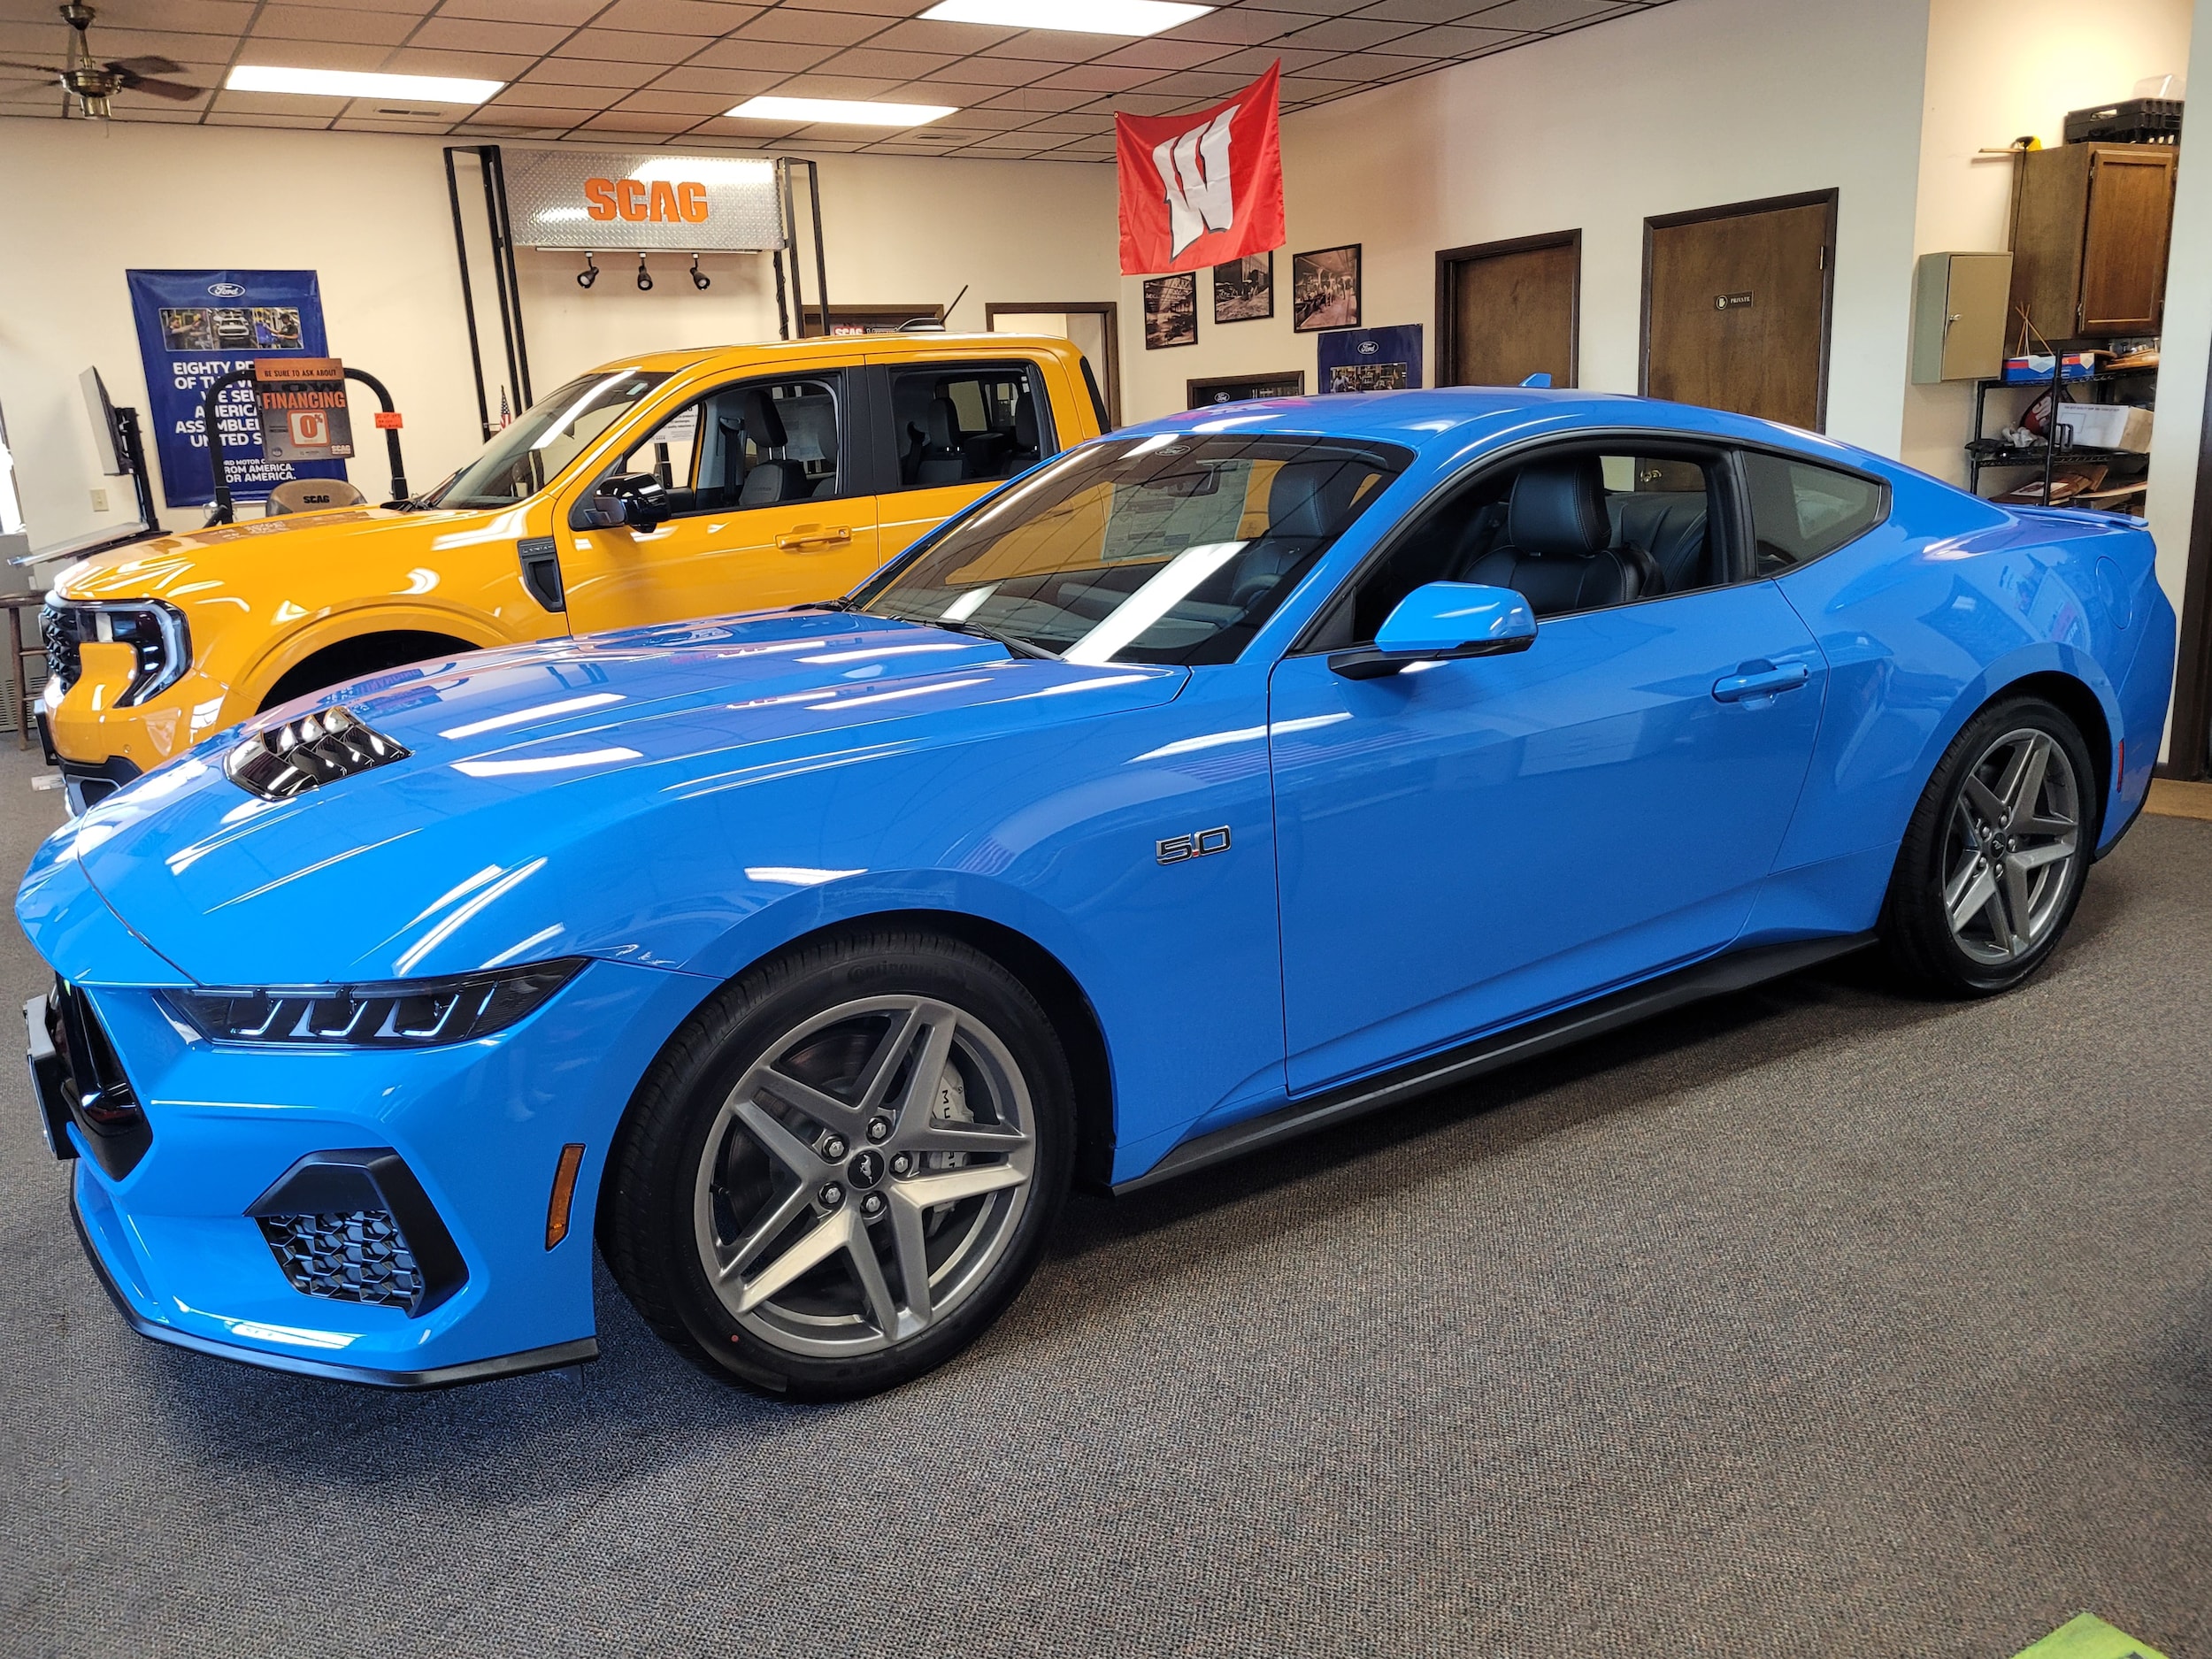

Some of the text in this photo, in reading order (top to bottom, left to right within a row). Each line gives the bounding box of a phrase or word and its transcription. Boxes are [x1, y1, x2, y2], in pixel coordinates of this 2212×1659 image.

[585, 178, 709, 223] SCAG
[212, 283, 242, 296] Ford
[1359, 342, 1377, 353] Ford
[173, 361, 231, 374] EIGHTY
[317, 368, 336, 377] ABOUT
[174, 376, 196, 390] OF
[262, 391, 346, 410] FINANCING
[249, 463, 296, 472] AMERICA.
[244, 471, 297, 482] AMERICA.
[1156, 824, 1233, 866] 5.0
